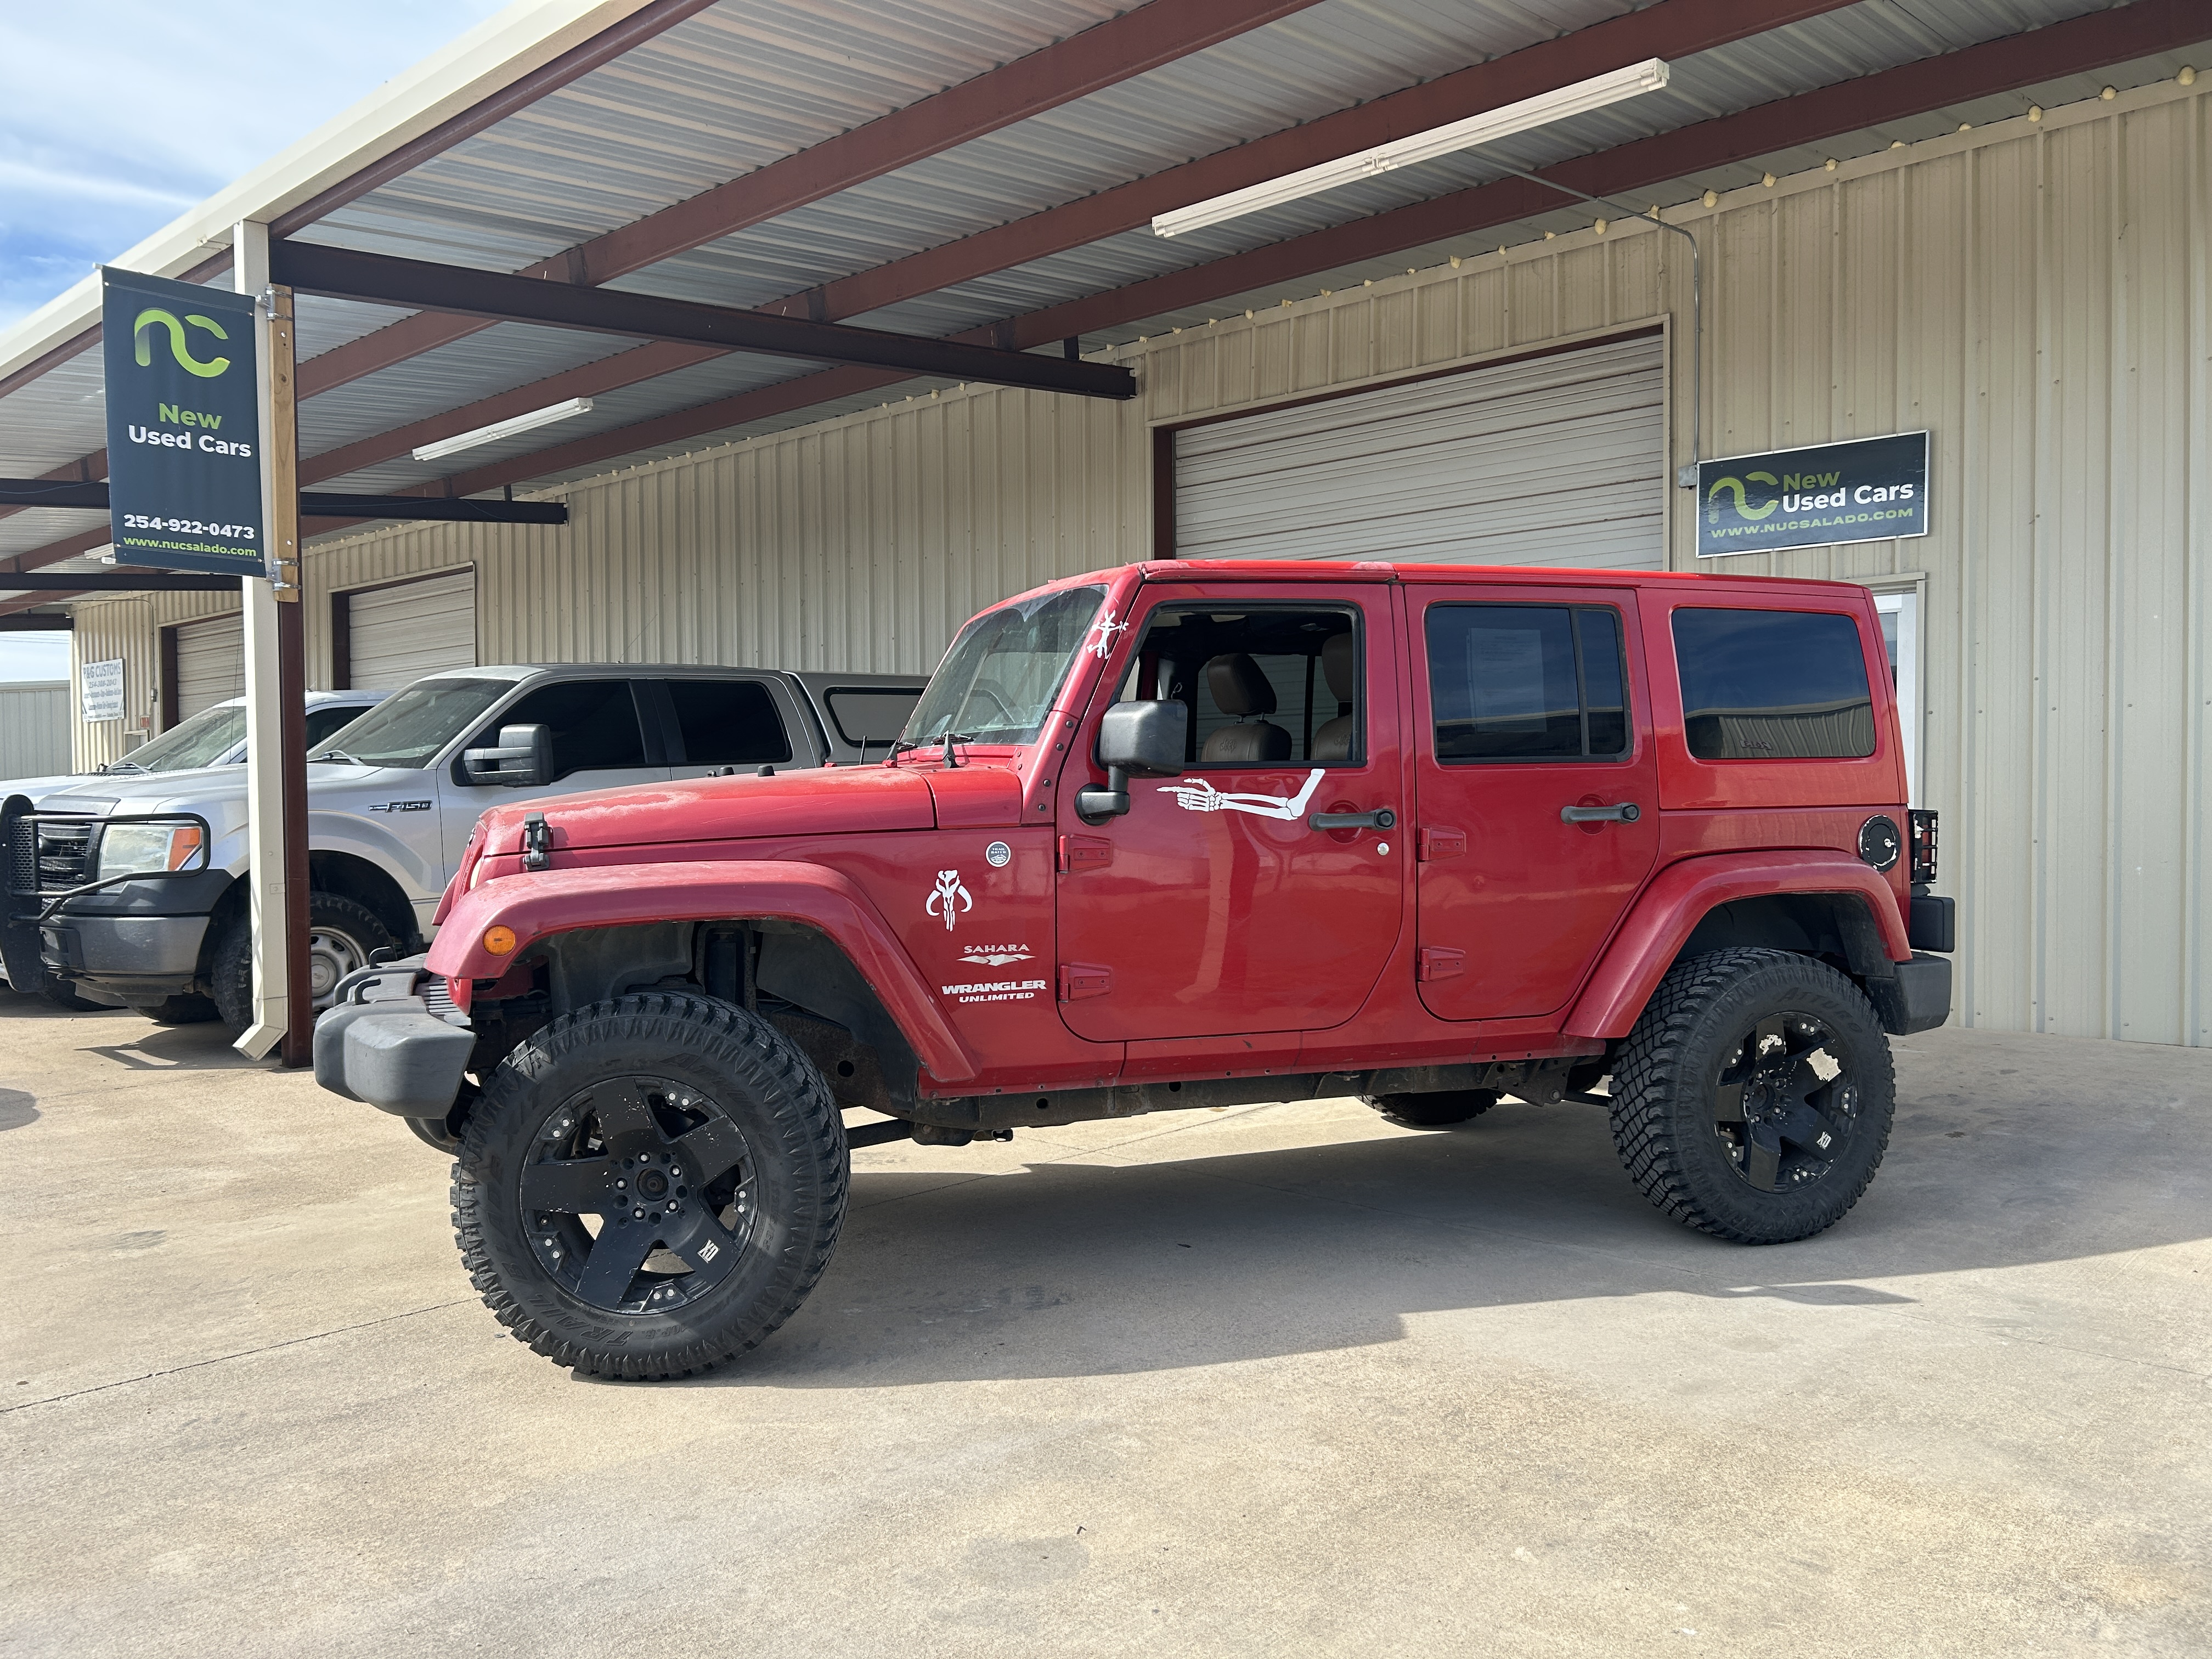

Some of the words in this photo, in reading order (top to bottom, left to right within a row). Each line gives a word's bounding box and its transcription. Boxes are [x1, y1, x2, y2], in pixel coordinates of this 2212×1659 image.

[159, 403, 222, 430] New
[128, 425, 191, 450] Used
[199, 435, 251, 458] Cars
[1783, 471, 1840, 492] New
[1782, 488, 1846, 513] Used
[1854, 483, 1914, 505] Cars
[123, 514, 255, 539] 254-922-0473
[1711, 508, 1912, 538] WWW.NUCSALADO.COM
[123, 535, 256, 557] www.nucsalado.com
[95, 662, 121, 678] CUSTOMS
[964, 944, 1029, 953] SAHARA
[941, 980, 1047, 995] WRANGLER
[959, 992, 1035, 1002] UNLIMITED
[1777, 987, 1863, 1032] ATTURO
[660, 1053, 780, 1156] ATTURO
[485, 1159, 531, 1289] BLADE
[526, 1289, 628, 1347] TRAIL
